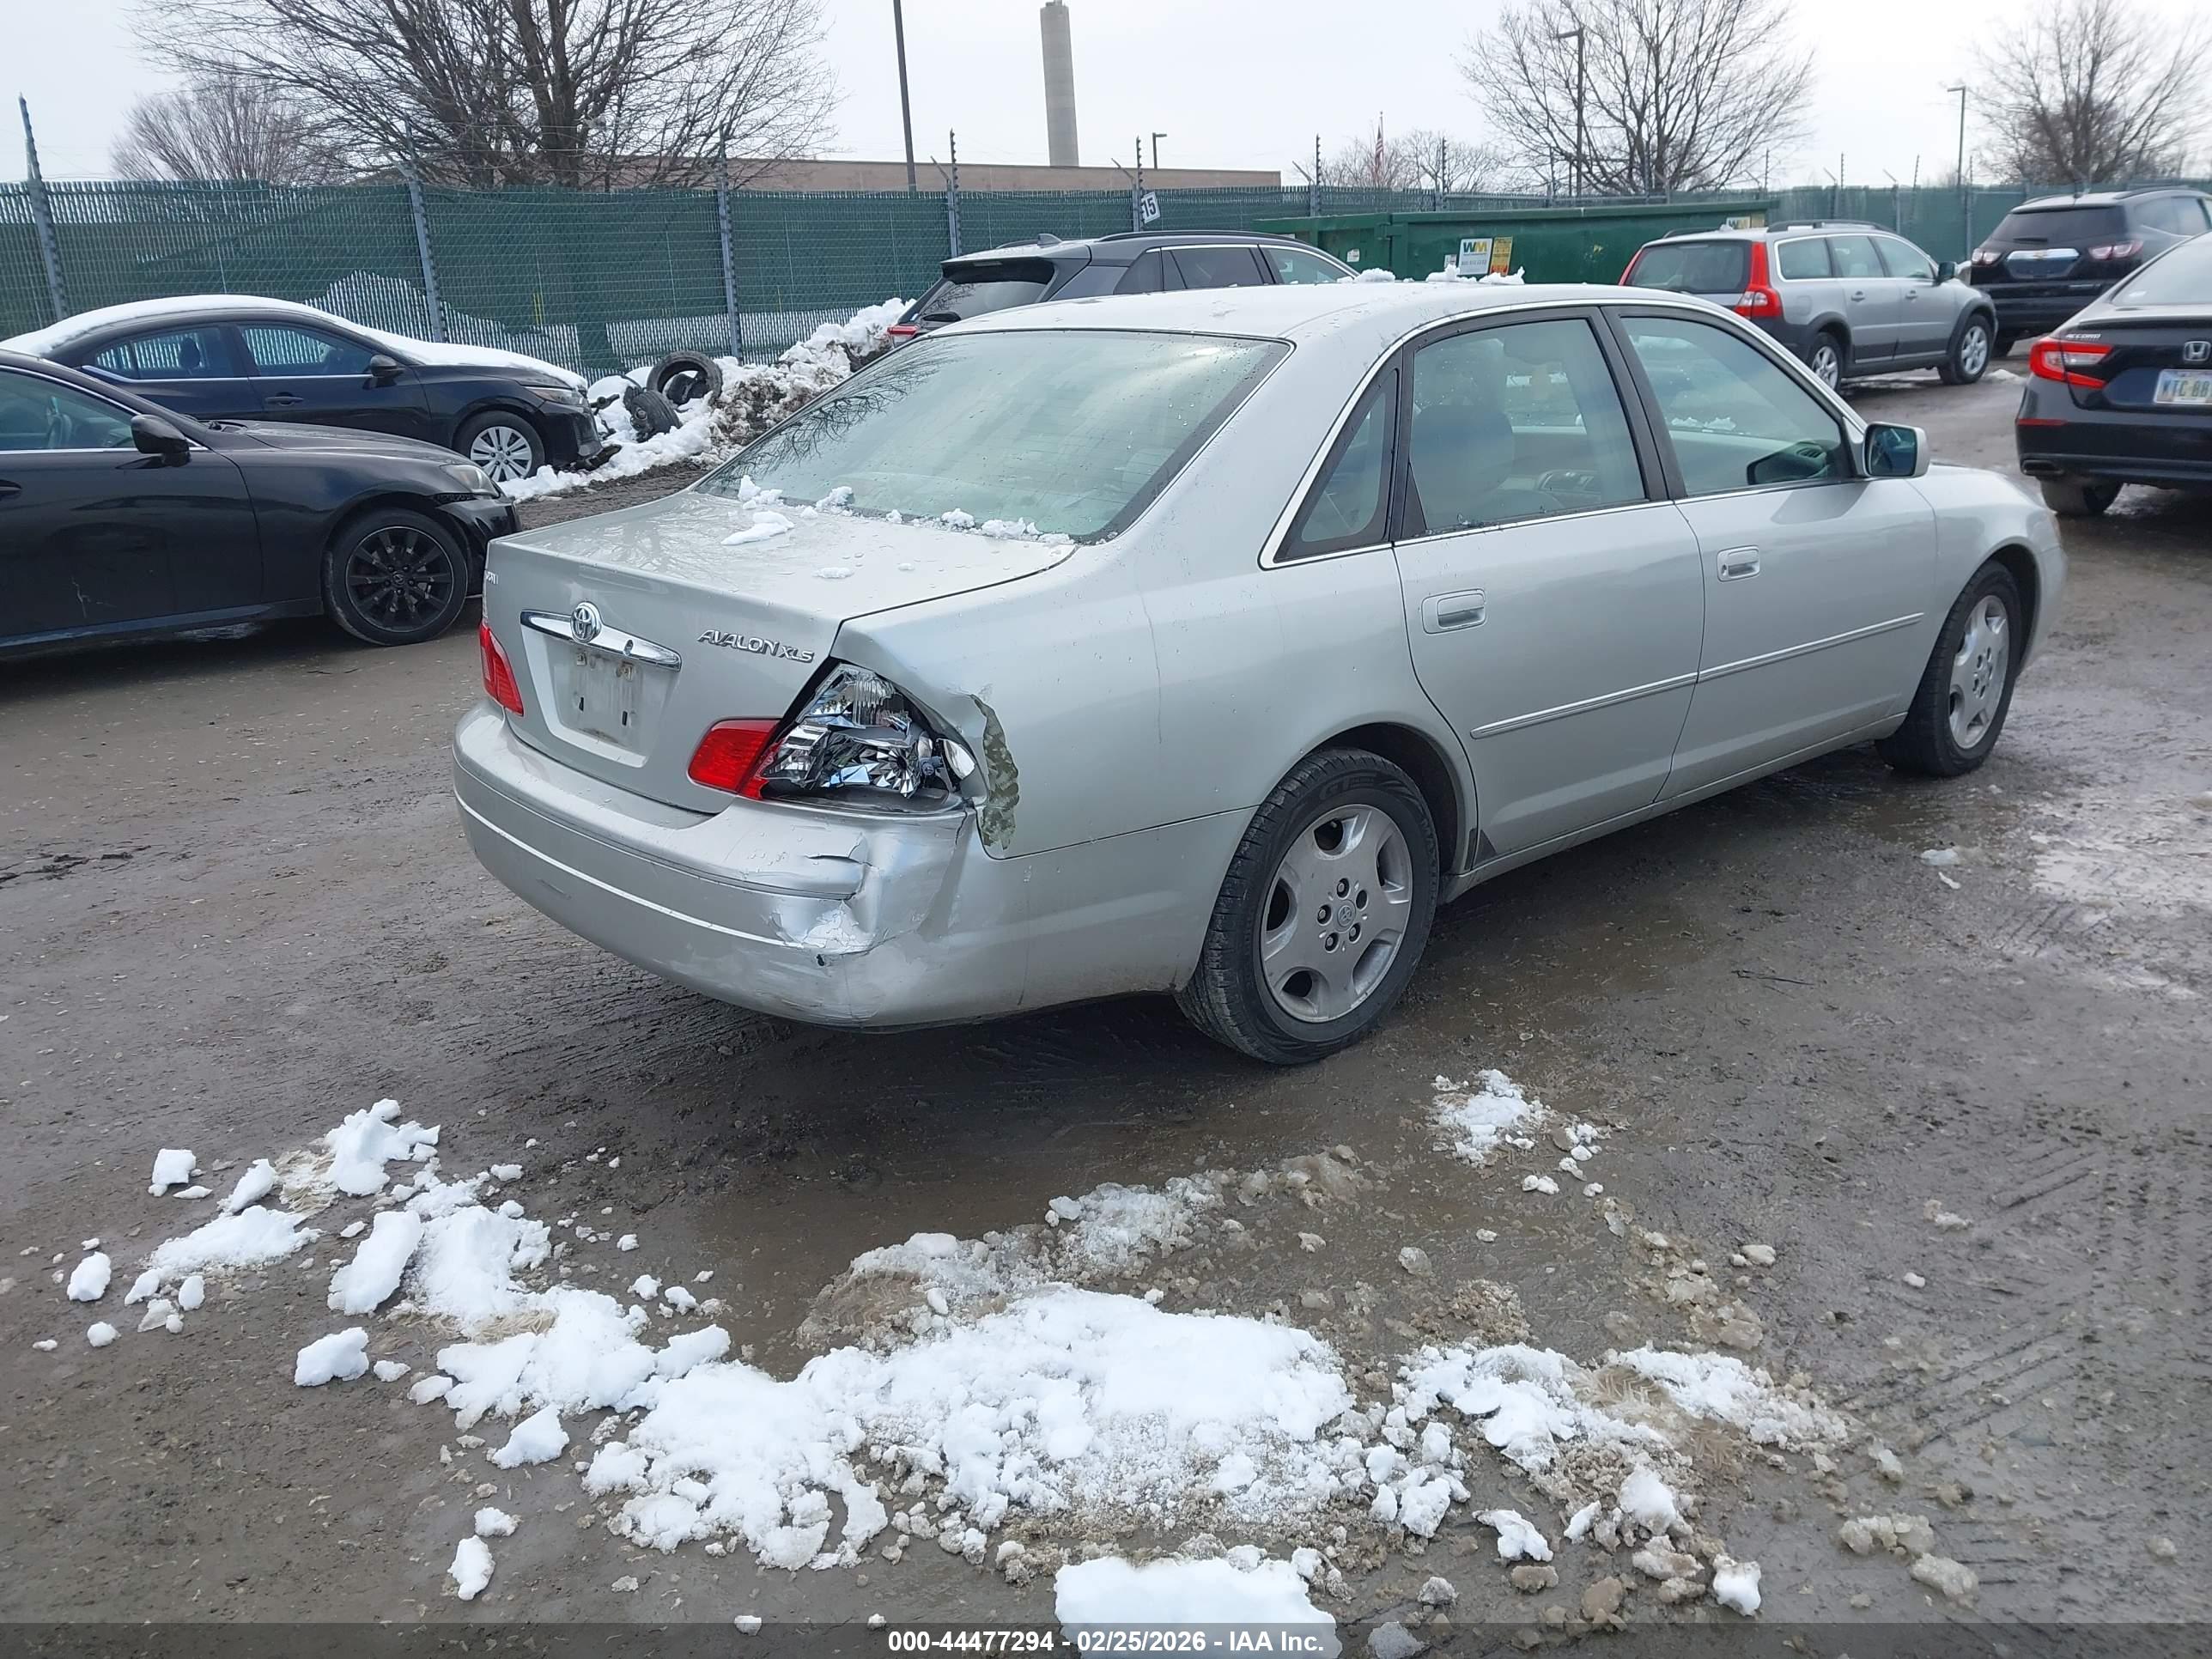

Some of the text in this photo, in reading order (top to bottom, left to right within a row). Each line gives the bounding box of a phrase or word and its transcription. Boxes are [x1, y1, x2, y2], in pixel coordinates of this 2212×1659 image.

[1143, 197, 1157, 217] 15
[1463, 241, 1488, 253] WM
[696, 629, 815, 664] AVALON XLS
